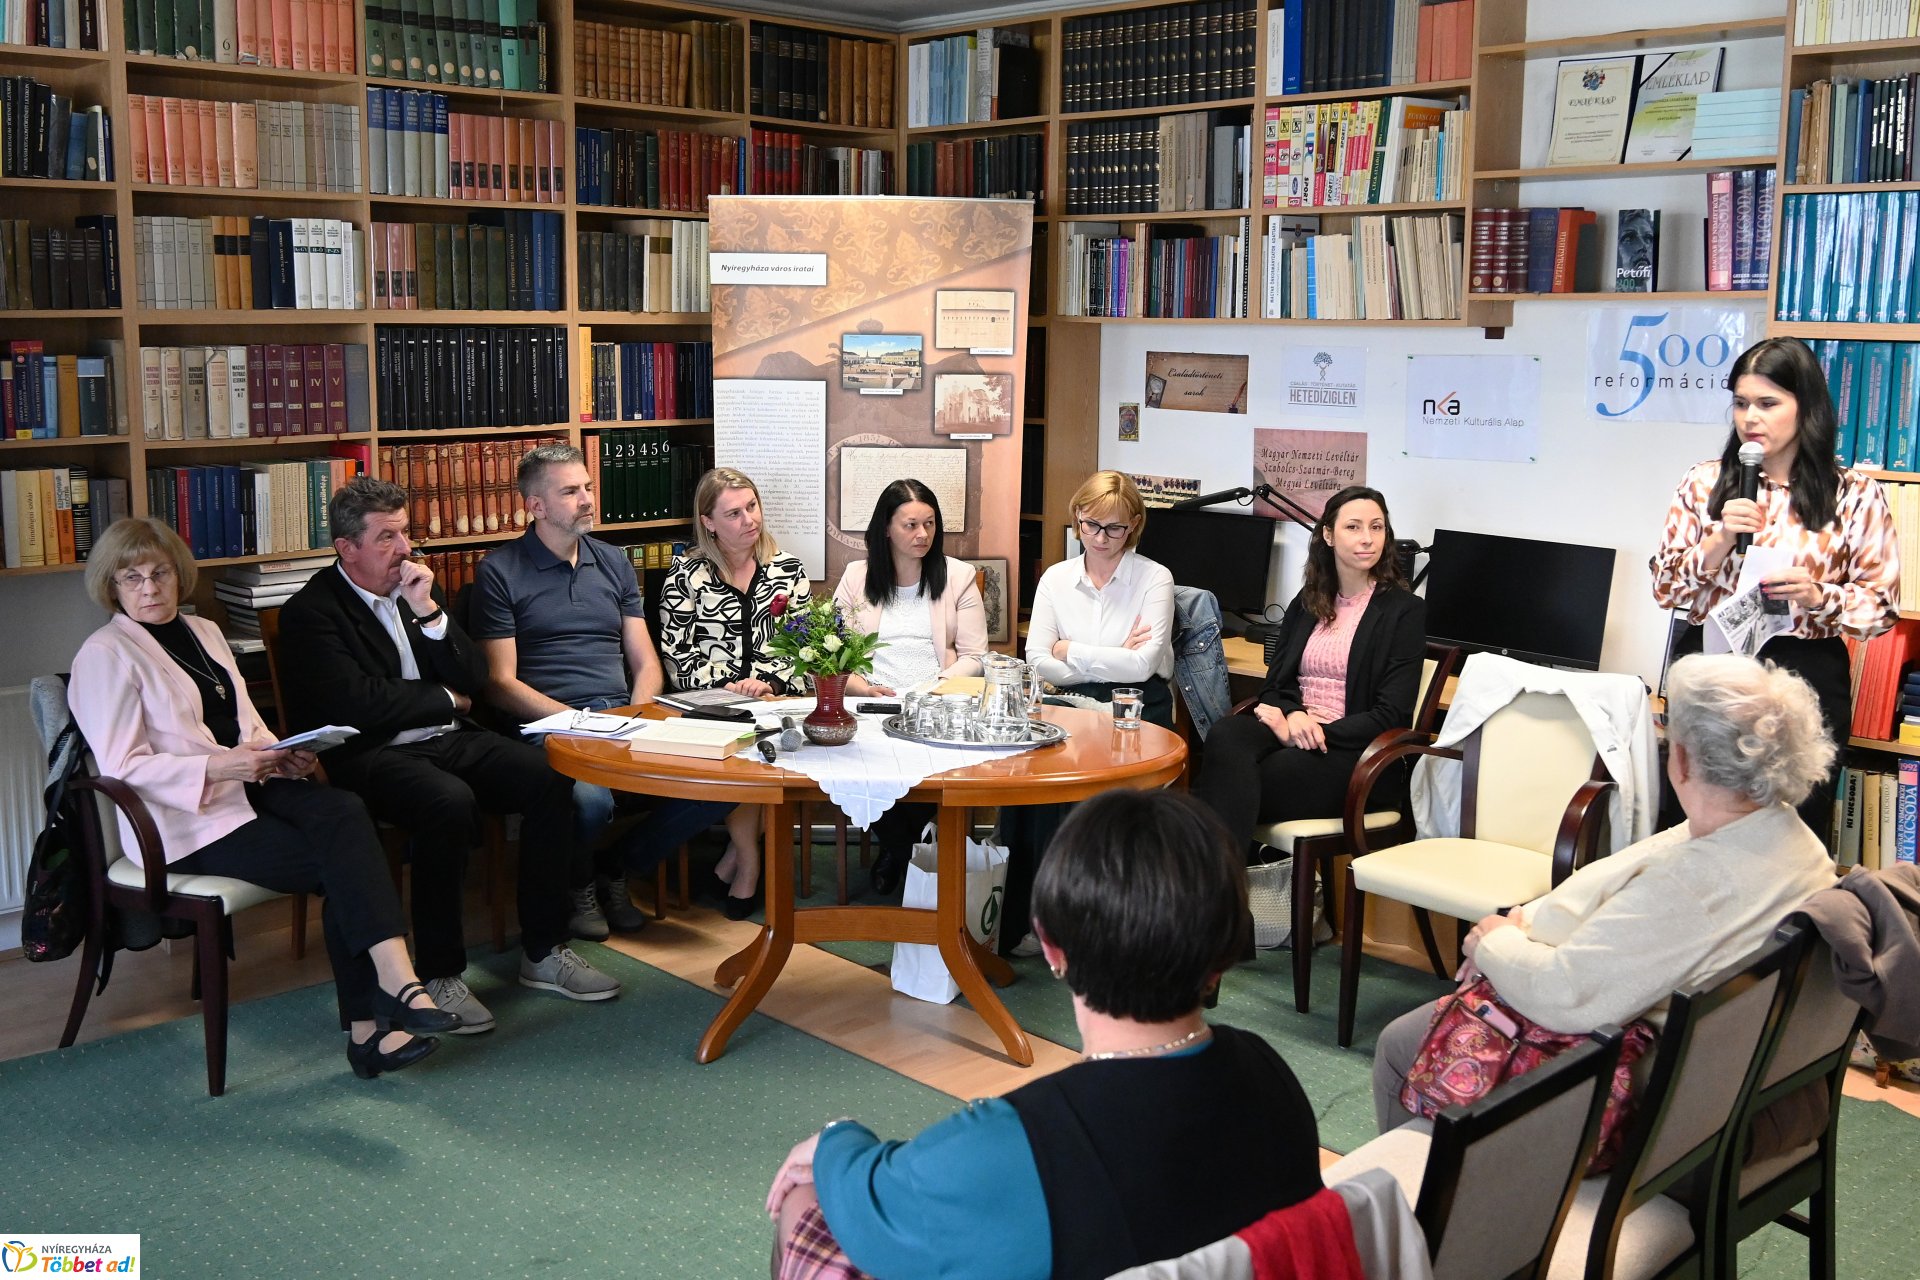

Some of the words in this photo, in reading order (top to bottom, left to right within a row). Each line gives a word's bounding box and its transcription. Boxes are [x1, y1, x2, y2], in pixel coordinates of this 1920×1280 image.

[222, 38, 231, 51] 6
[1644, 70, 1711, 91] EMLÉKLAP
[1736, 187, 1753, 244] KICSODA
[1756, 187, 1774, 245] KICSODA
[720, 264, 770, 273] Nyíregyháza
[792, 265, 815, 273] iratai
[1616, 265, 1652, 279] Petőfi
[1595, 311, 1730, 417] 500
[1167, 367, 1224, 380] Családtörténeti
[256, 378, 260, 387] I
[272, 377, 279, 387] II
[289, 379, 299, 388] III
[311, 378, 321, 387] IV
[332, 377, 340, 386] V
[1593, 372, 1731, 390] reformáció
[1183, 385, 1208, 397] sarok
[1289, 387, 1356, 405] HETEDÍZIGLEN
[1421, 416, 1461, 426] Nemzeti
[1463, 416, 1502, 427] Kulturális
[1503, 417, 1525, 428] Alap
[604, 442, 611, 456] 1
[615, 444, 623, 458] 2
[627, 443, 635, 457] 3
[639, 442, 648, 456] 4
[651, 442, 659, 456] 5
[662, 439, 670, 453] 6
[1260, 448, 1290, 462] Magyar
[1291, 449, 1323, 461] Nemzeti
[1325, 450, 1360, 463] Levéltár
[1263, 461, 1356, 481] Szabolcs-Szatmár-Bereg
[1275, 477, 1302, 492] Megyei
[1303, 479, 1341, 491] Levéltára
[320, 504, 328, 520] erők
[1899, 762, 1918, 772] 1992
[1903, 785, 1918, 846] KICSODA
